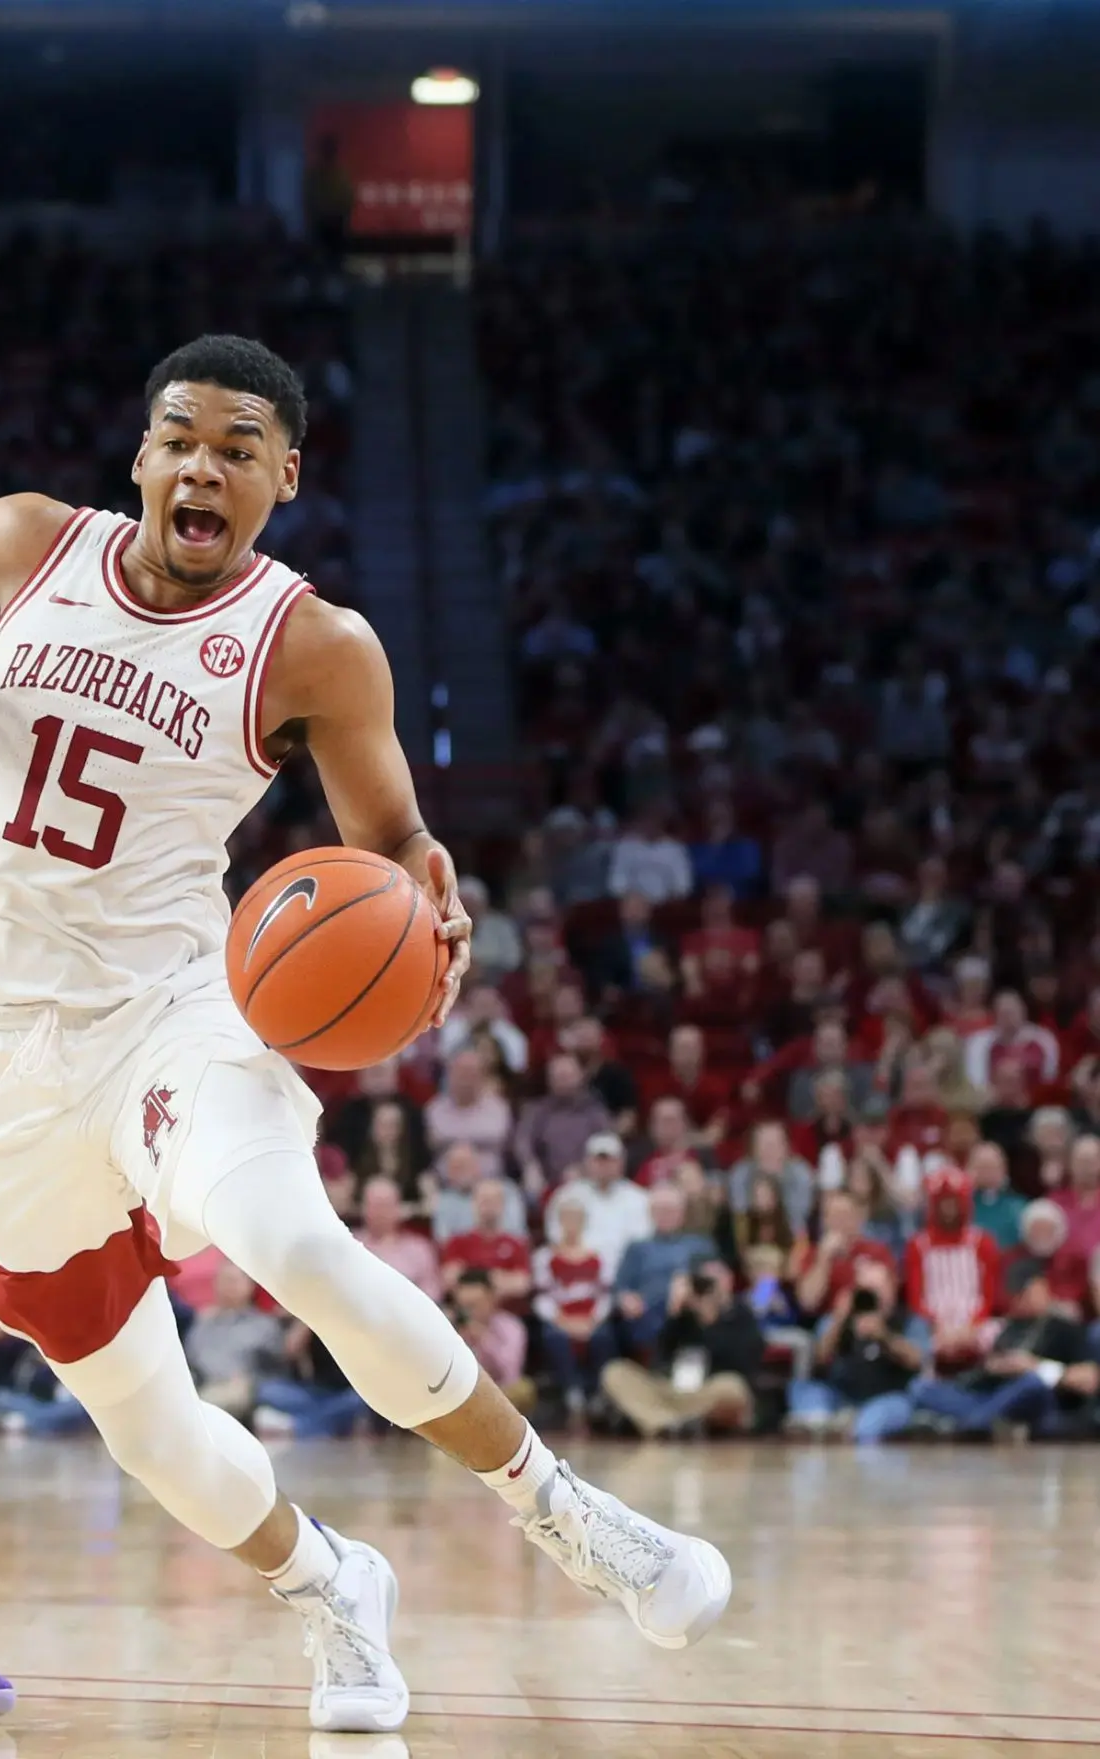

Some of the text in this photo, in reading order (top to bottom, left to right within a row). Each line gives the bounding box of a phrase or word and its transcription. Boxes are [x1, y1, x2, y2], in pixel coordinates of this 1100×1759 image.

[0, 644, 210, 760] RAZORBACKS
[202, 635, 244, 676] SEC
[2, 714, 145, 870] 15
